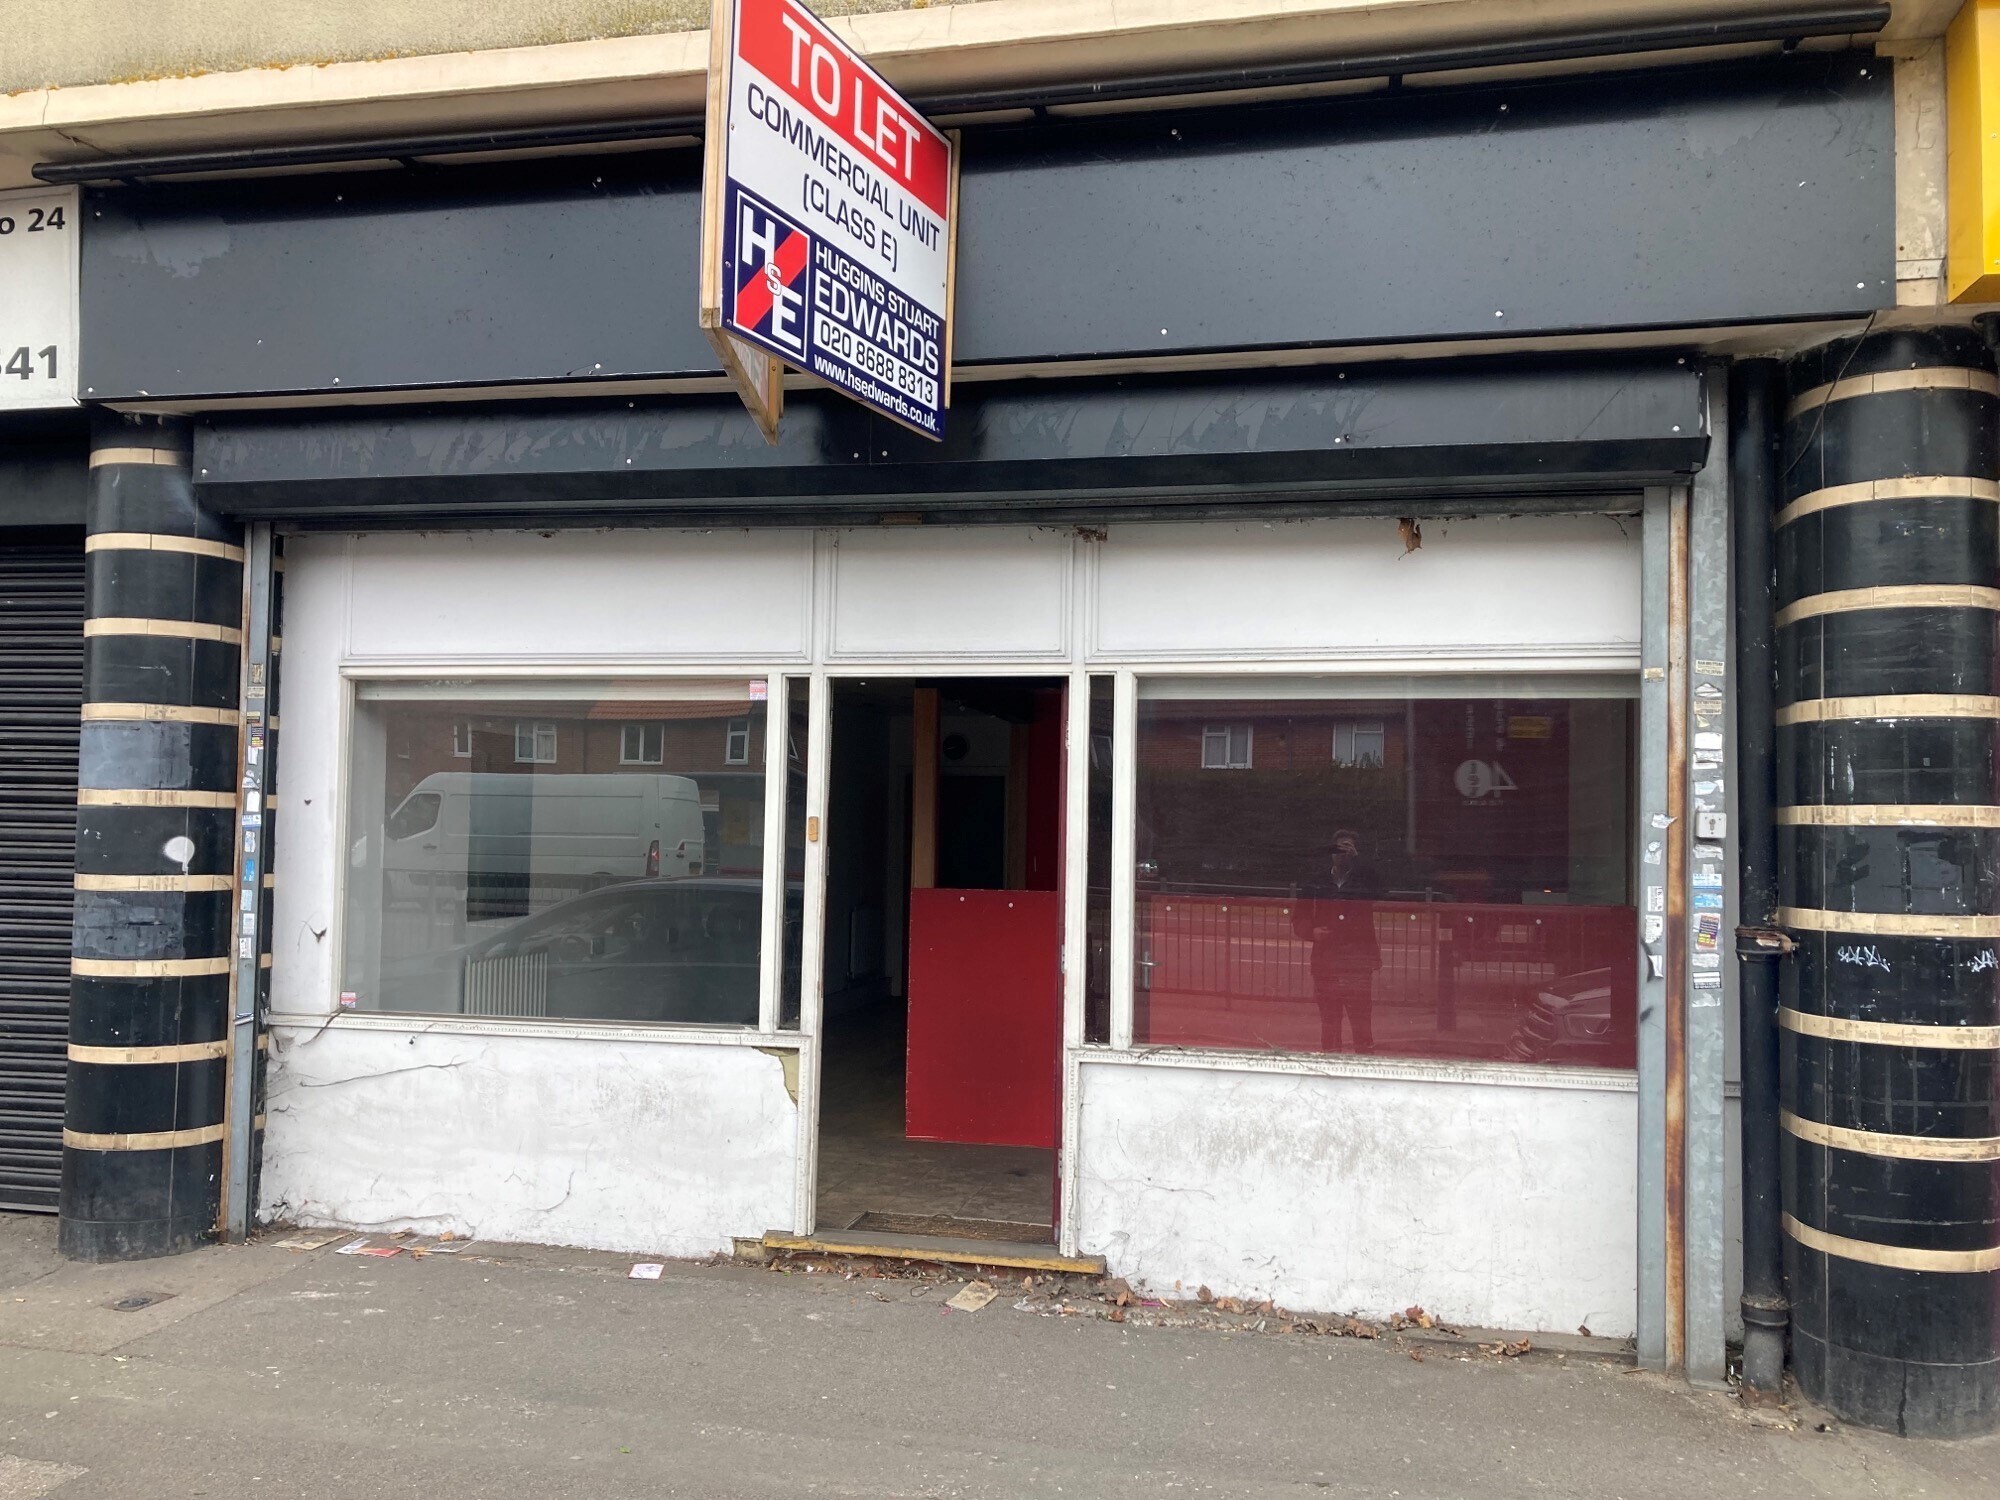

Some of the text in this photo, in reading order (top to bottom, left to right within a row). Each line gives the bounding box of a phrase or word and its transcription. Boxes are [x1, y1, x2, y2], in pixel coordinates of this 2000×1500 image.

[782, 11, 922, 182] TO LET
[747, 82, 940, 252] COMMERCIAL UNIT
[27, 206, 66, 232] 24
[803, 173, 898, 272] (CLASS E)
[814, 268, 940, 377] EDWARDS
[815, 241, 940, 340] HUGGINS STUART
[0, 344, 58, 381] 41
[813, 353, 936, 432] www.hsedwards.co.uk
[819, 319, 934, 405] 020 8688 8313
